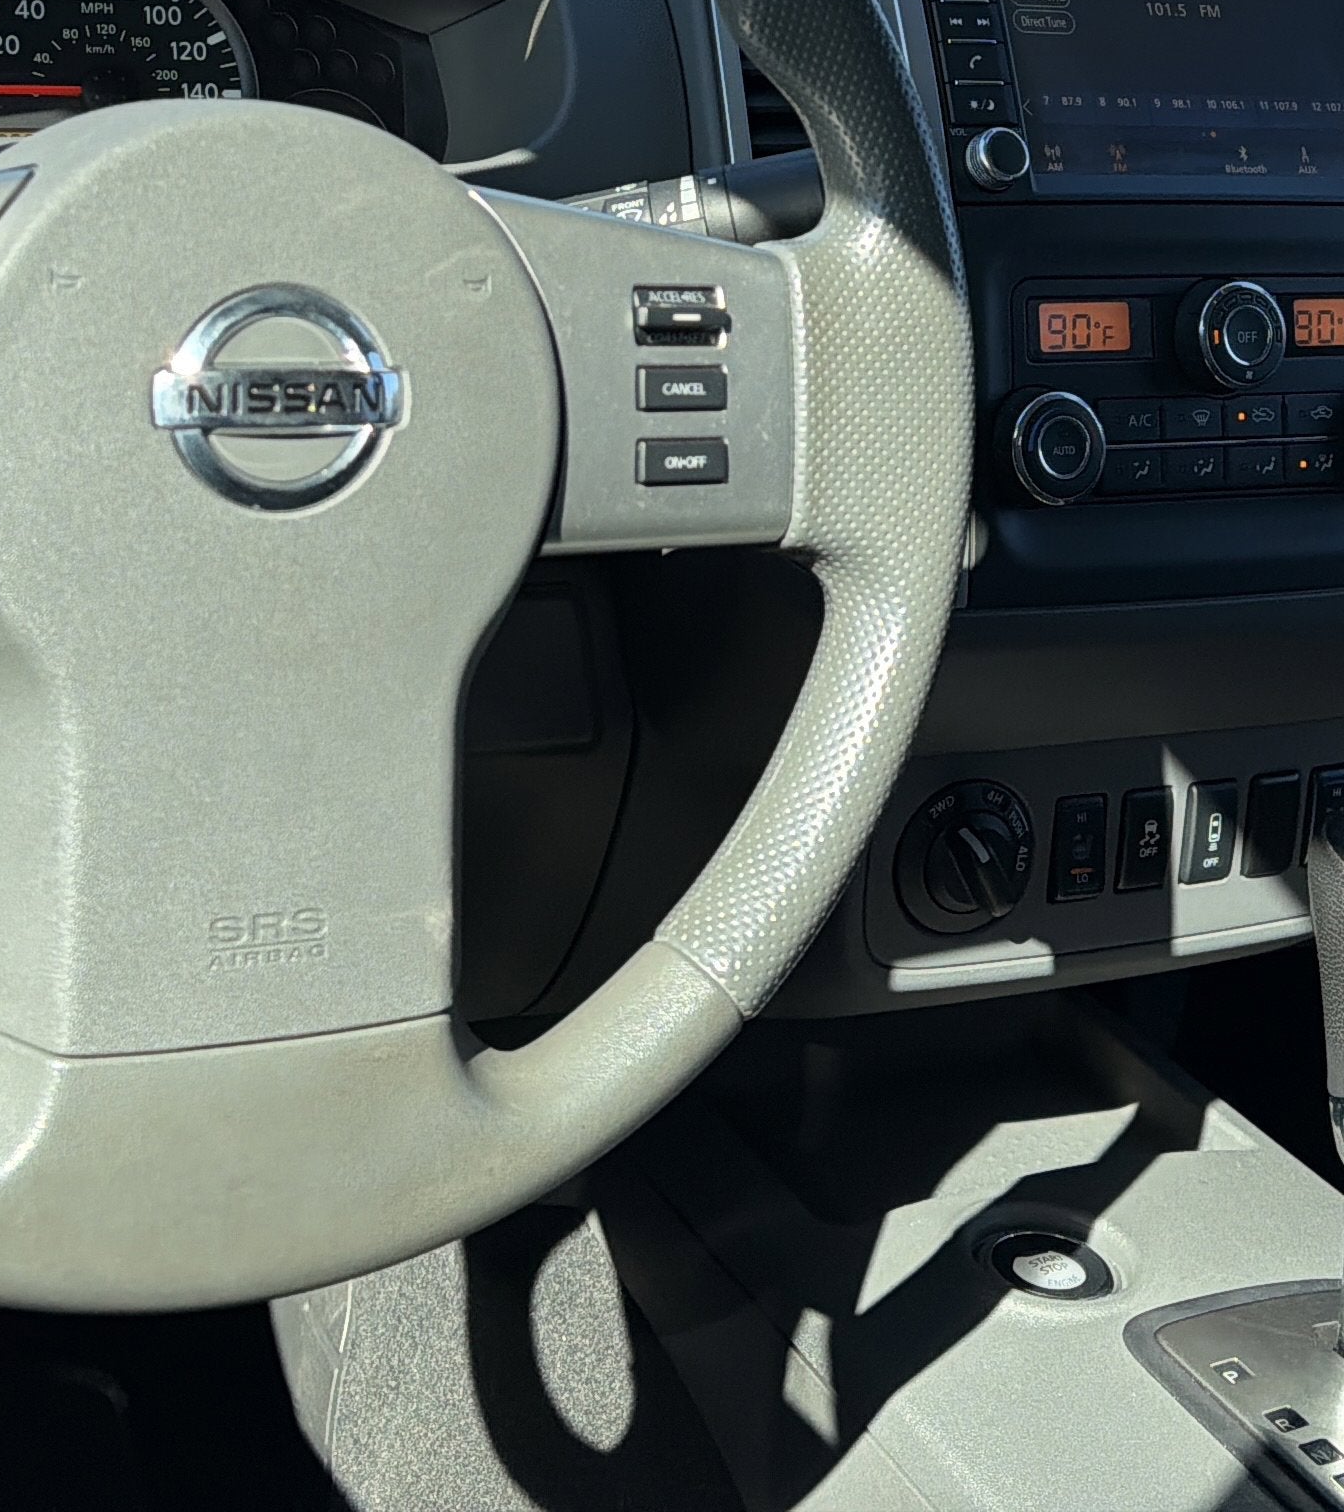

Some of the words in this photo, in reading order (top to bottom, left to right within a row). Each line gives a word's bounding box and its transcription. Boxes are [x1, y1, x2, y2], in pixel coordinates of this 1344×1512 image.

[14, 0, 45, 20] 40
[80, 2, 114, 14] MPH
[1145, 1, 1188, 17] 101.5
[1199, 4, 1221, 19] FM
[143, 5, 182, 26] 100
[1020, 15, 1046, 27] Direct
[1046, 15, 1067, 28] Tune
[62, 28, 79, 40] 80
[96, 23, 116, 35] 120
[85, 43, 115, 55] km/h
[130, 36, 150, 48] 160
[169, 41, 207, 61] 120
[33, 53, 49, 64] 40
[156, 70, 178, 81] 200
[181, 82, 218, 100] 140
[1061, 96, 1082, 107] 87.9
[1117, 97, 1137, 108] 90.1
[1172, 98, 1192, 109] 98.1
[1220, 100, 1245, 110] 106.1
[1273, 100, 1298, 111] 107.9
[949, 128, 968, 136] VOL
[1225, 163, 1268, 174] Bluetooth
[1298, 165, 1318, 175] AUX
[611, 198, 645, 212] FRONT
[1237, 330, 1258, 343] OFF
[662, 382, 707, 396] CANCEL
[185, 378, 386, 417] NISSAN
[1128, 413, 1152, 429] A/C
[1053, 445, 1076, 457] AUTO
[928, 795, 955, 819] 2WD
[1076, 813, 1087, 823] HI
[1015, 845, 1029, 872] 4LO
[1139, 847, 1159, 858] OFF
[1203, 855, 1220, 868] OFF
[208, 906, 329, 942] SRS
[208, 943, 330, 971] AIRBAG
[1028, 1254, 1064, 1268] START
[1039, 1262, 1069, 1276] STOP
[1222, 1370, 1239, 1385] P
[1274, 1418, 1294, 1433] R
